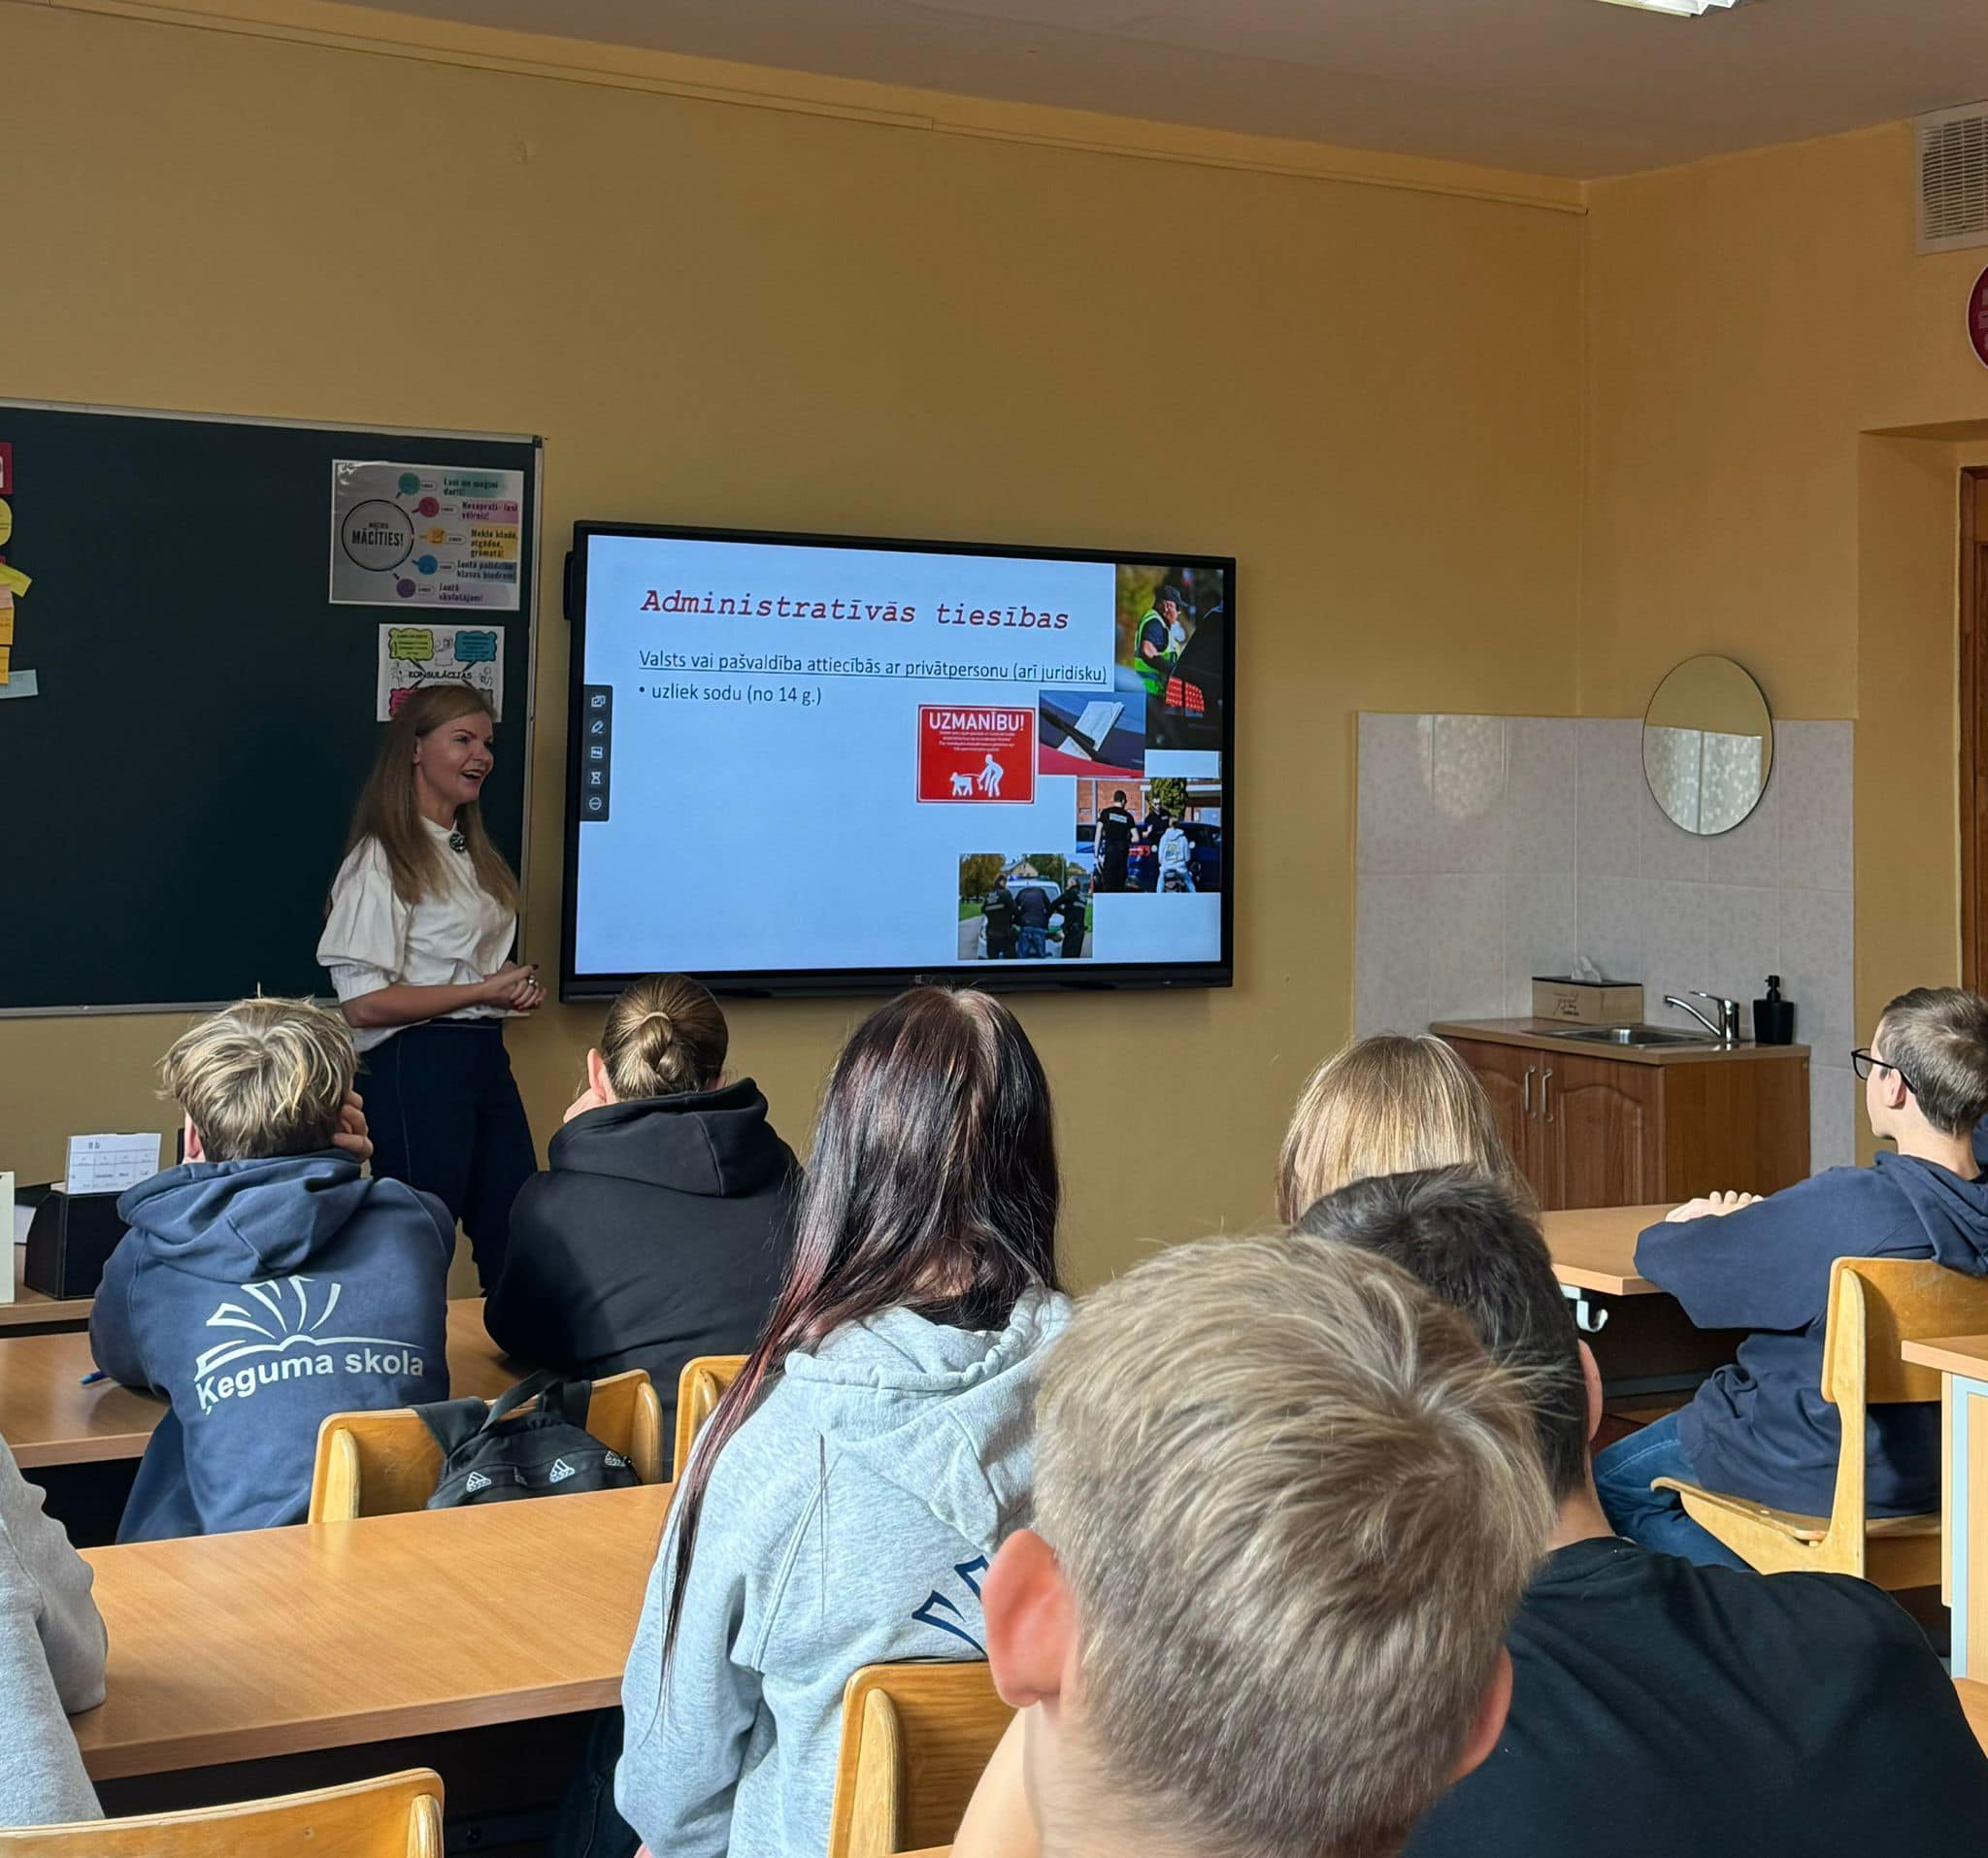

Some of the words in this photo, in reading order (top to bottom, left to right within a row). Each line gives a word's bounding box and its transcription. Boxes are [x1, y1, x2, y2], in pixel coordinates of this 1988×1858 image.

[351, 527, 404, 547] MĀCĪTIES!
[640, 589, 915, 623] Administratīvās
[936, 603, 1069, 629] tiesības
[639, 650, 686, 668] Valsts
[690, 652, 713, 669] vai
[718, 653, 803, 672] pašvaldība
[807, 657, 880, 675] attiecībās
[885, 662, 900, 675] ar
[905, 661, 1009, 680] privātpersonu
[1012, 663, 1038, 681] (arī
[1041, 665, 1108, 684] juridisku)
[651, 683, 698, 700] uzliek
[703, 683, 742, 700] sodu
[746, 684, 774, 705] (no
[779, 686, 797, 702] 14
[802, 687, 821, 707] g.)
[929, 712, 1024, 732] UZMANĪBU!
[195, 1352, 334, 1415] Ķeguma
[345, 1347, 424, 1377] skola
